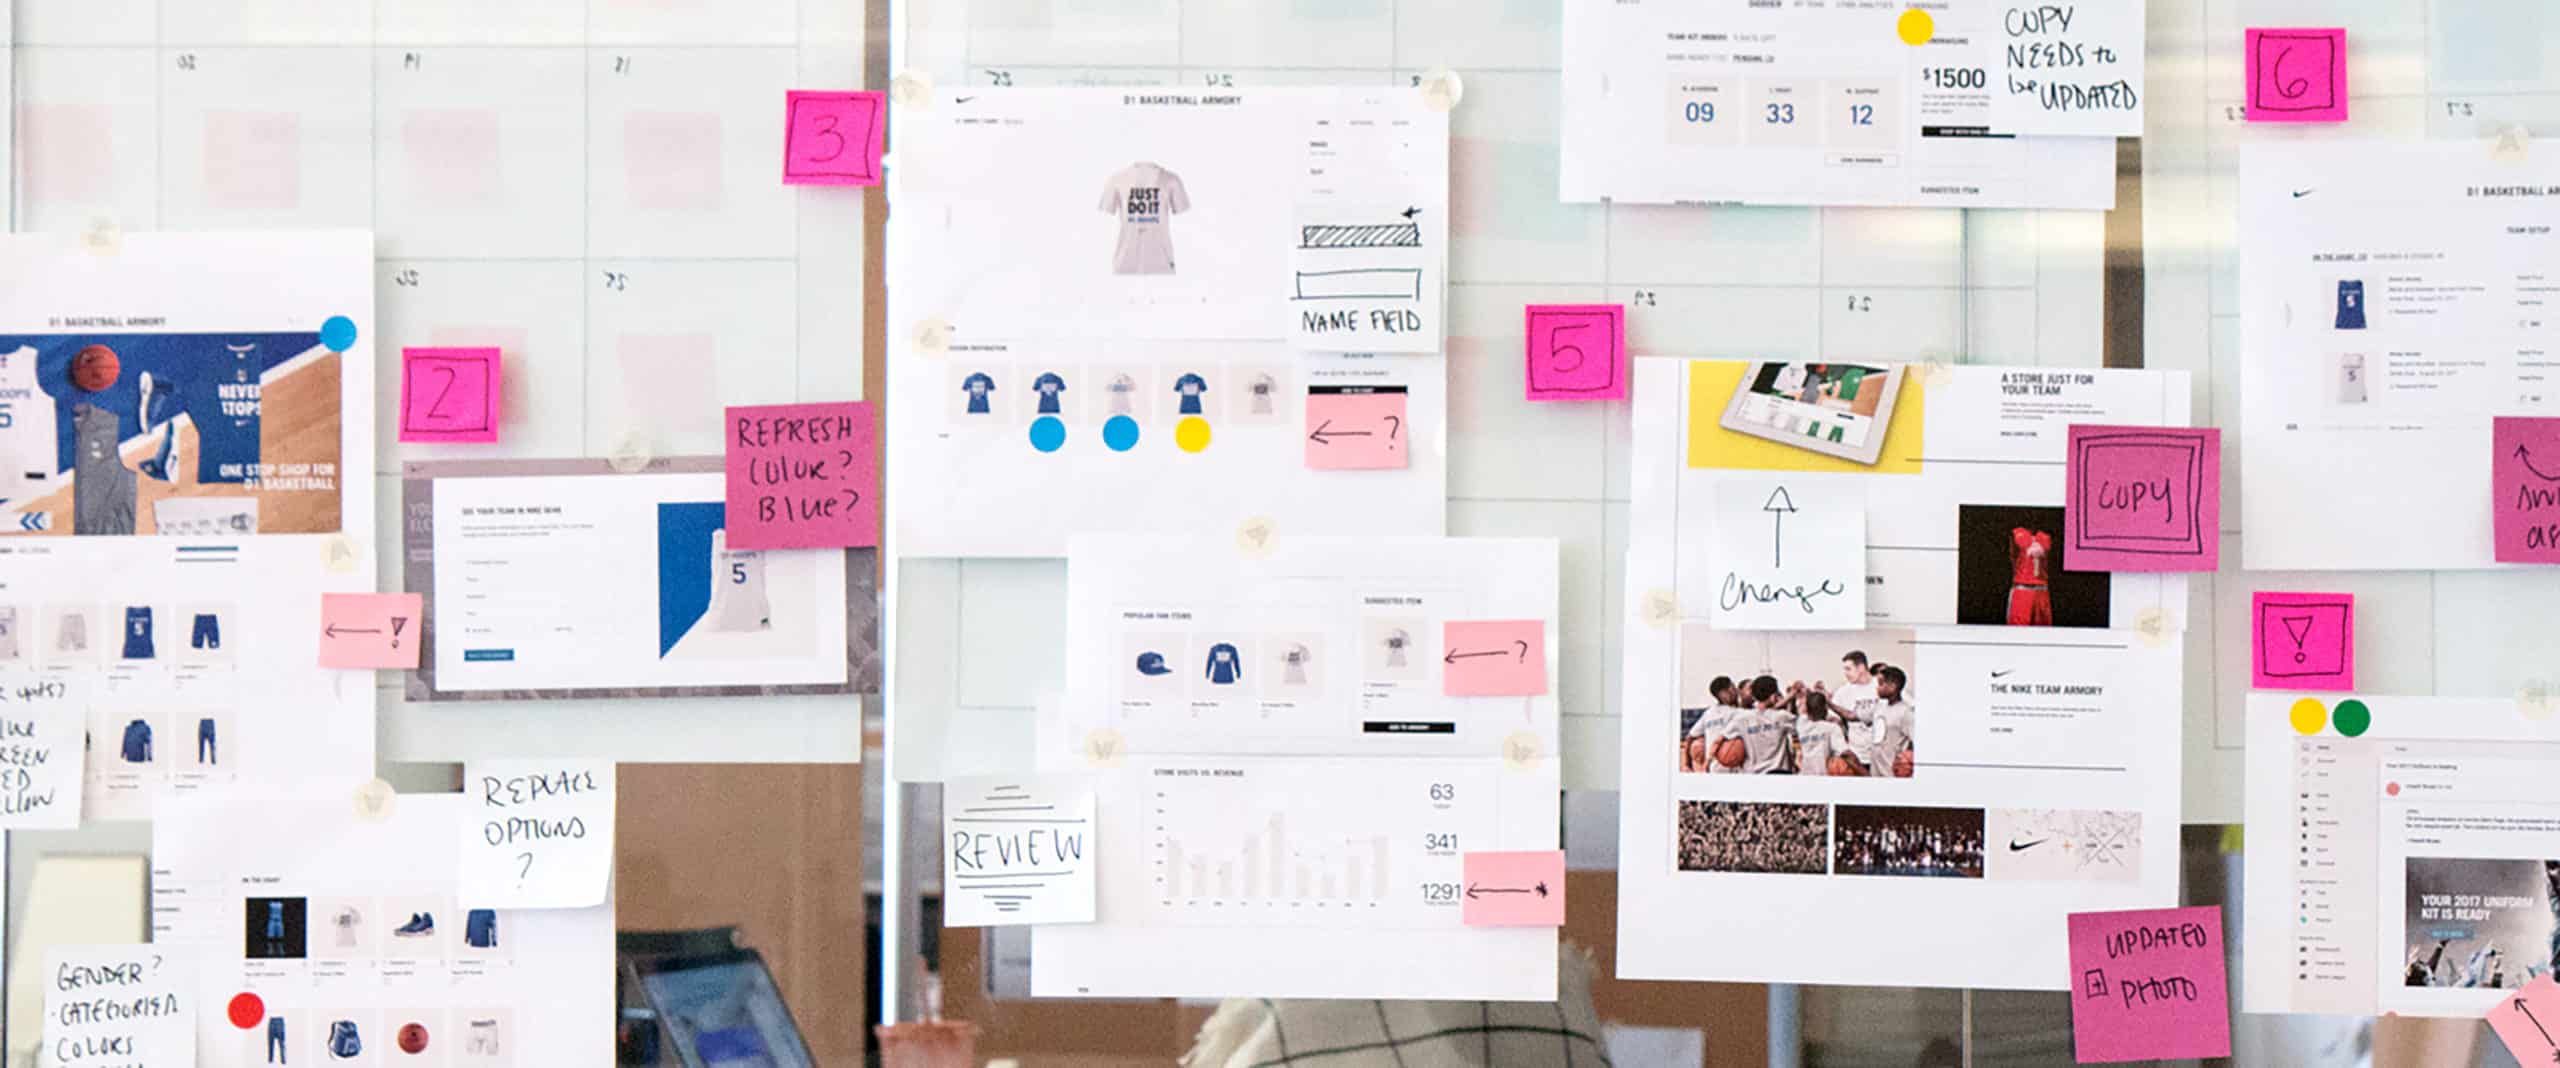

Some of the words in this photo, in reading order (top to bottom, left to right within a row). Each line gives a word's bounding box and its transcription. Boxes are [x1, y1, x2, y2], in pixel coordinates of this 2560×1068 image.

[2004, 5, 2074, 37] COPY
[2007, 40, 2084, 69] NEEDS
[2091, 45, 2117, 63] to
[2274, 46, 2308, 99] 6
[1140, 96, 1198, 105] BASKETBALL
[2008, 73, 2038, 95] be
[2041, 79, 2137, 112] UPDATED
[1685, 102, 1714, 122] 09
[1766, 103, 1795, 124] 33
[1851, 104, 1873, 125] 12
[808, 114, 846, 163] 3
[1128, 187, 1161, 201] JUST
[2483, 186, 2544, 197] BASKETBALL
[1127, 201, 1145, 215] DO
[1147, 201, 1161, 215] IT
[1302, 309, 1358, 333] NAME
[1370, 309, 1422, 334] FIELD
[1551, 324, 1591, 373] 5
[2001, 373, 2009, 383] A
[2011, 373, 2043, 384] STORE
[2047, 374, 2072, 385] JUST
[2075, 374, 2095, 385] FOR
[2001, 385, 2029, 395] YOUR
[2033, 386, 2061, 396] TEAM
[427, 367, 457, 418] 2
[737, 416, 853, 448] REFRESH
[1383, 414, 1400, 451] ?
[2098, 477, 2173, 524] COPY
[732, 563, 747, 584] 5
[1514, 639, 1529, 664] ?
[1991, 683, 2008, 694] THE
[2011, 684, 2032, 694] NIKE
[2035, 684, 2061, 695] TEAM
[2063, 685, 2103, 696] ARMORY
[482, 770, 599, 807] REPLACE
[1429, 783, 1455, 800] 63
[484, 815, 586, 846] OPTIONS
[1425, 833, 1458, 850] 341
[952, 828, 1082, 872] REVIEW
[516, 851, 533, 890] ?
[1421, 883, 1462, 900] 1291
[2421, 894, 2452, 907] YOUR
[2454, 895, 2481, 907] 2017
[2483, 896, 2534, 909] UNIFORM
[2455, 908, 2492, 921] READY
[2106, 922, 2207, 959] UPDATED
[2120, 976, 2198, 1010] PHOTO
[60, 992, 179, 1027] CATEGORIES
